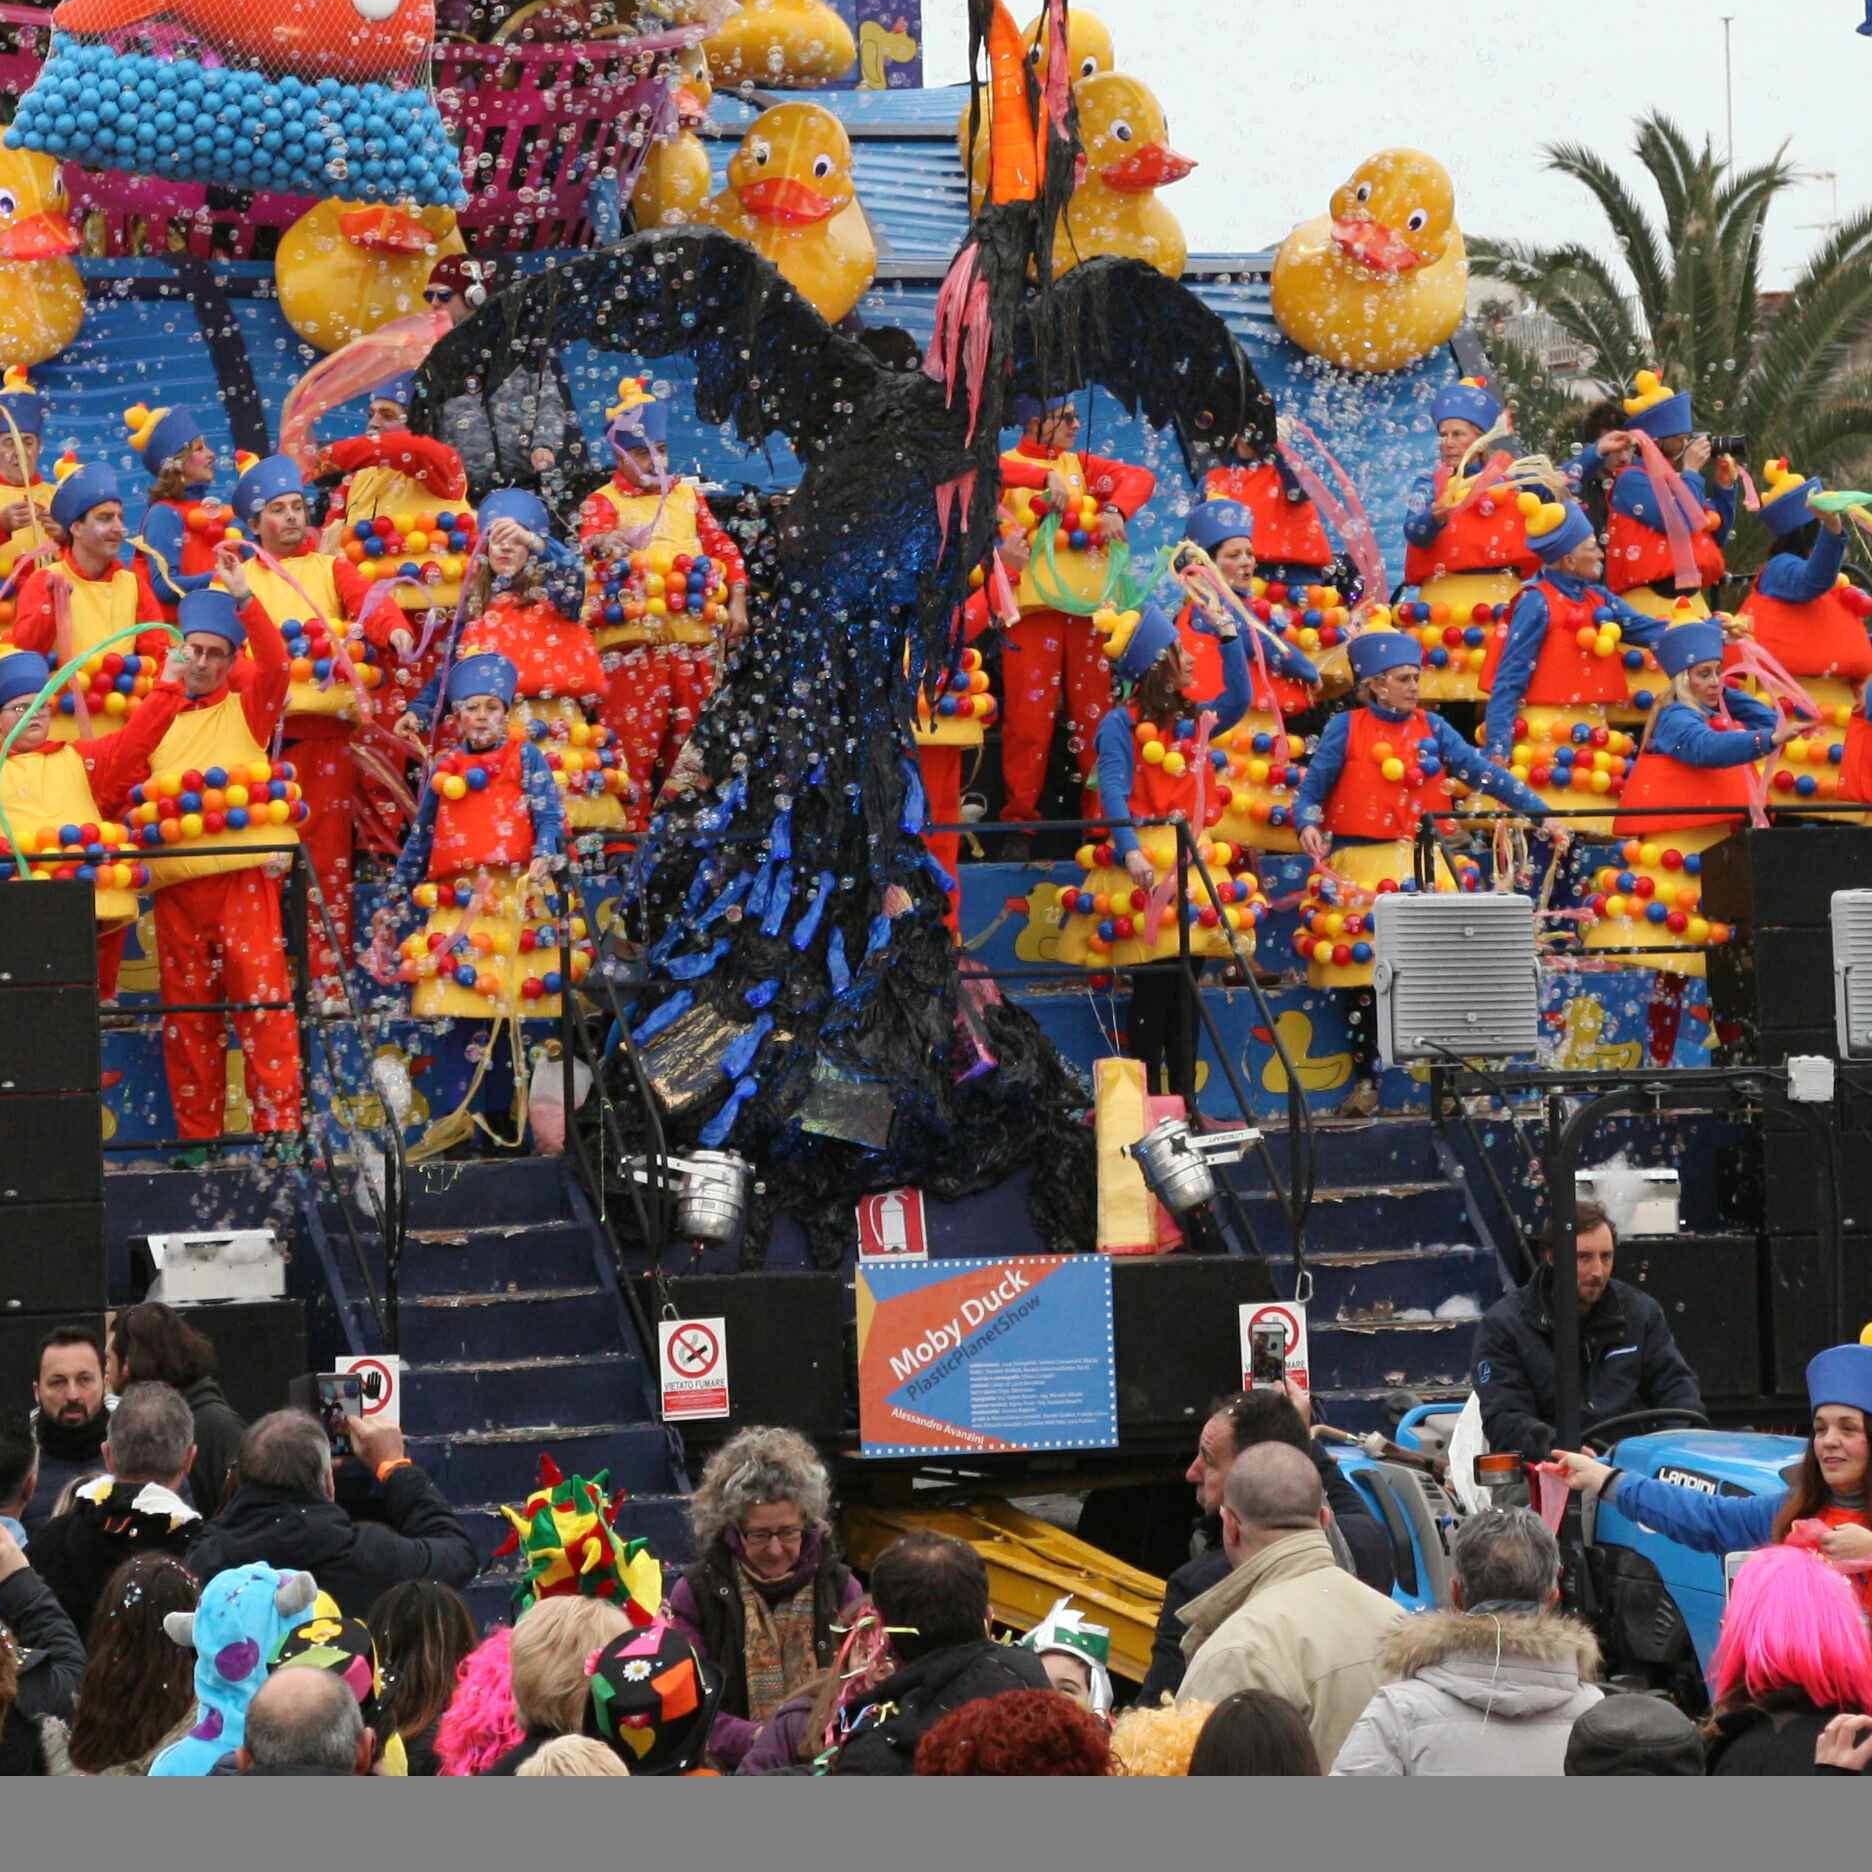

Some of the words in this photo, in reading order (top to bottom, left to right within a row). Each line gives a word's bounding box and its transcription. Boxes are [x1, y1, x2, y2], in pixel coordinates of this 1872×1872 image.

[889, 1317, 962, 1382] Moby
[960, 1267, 1030, 1328] Duck
[906, 1295, 1041, 1402] PlasticPlanetShow
[663, 1380, 695, 1392] VIETATO
[695, 1378, 726, 1390] FUMARE
[890, 1407, 943, 1432] Alessandro
[943, 1424, 985, 1445] Avanzini
[1658, 1466, 1717, 1497] LANDINI
